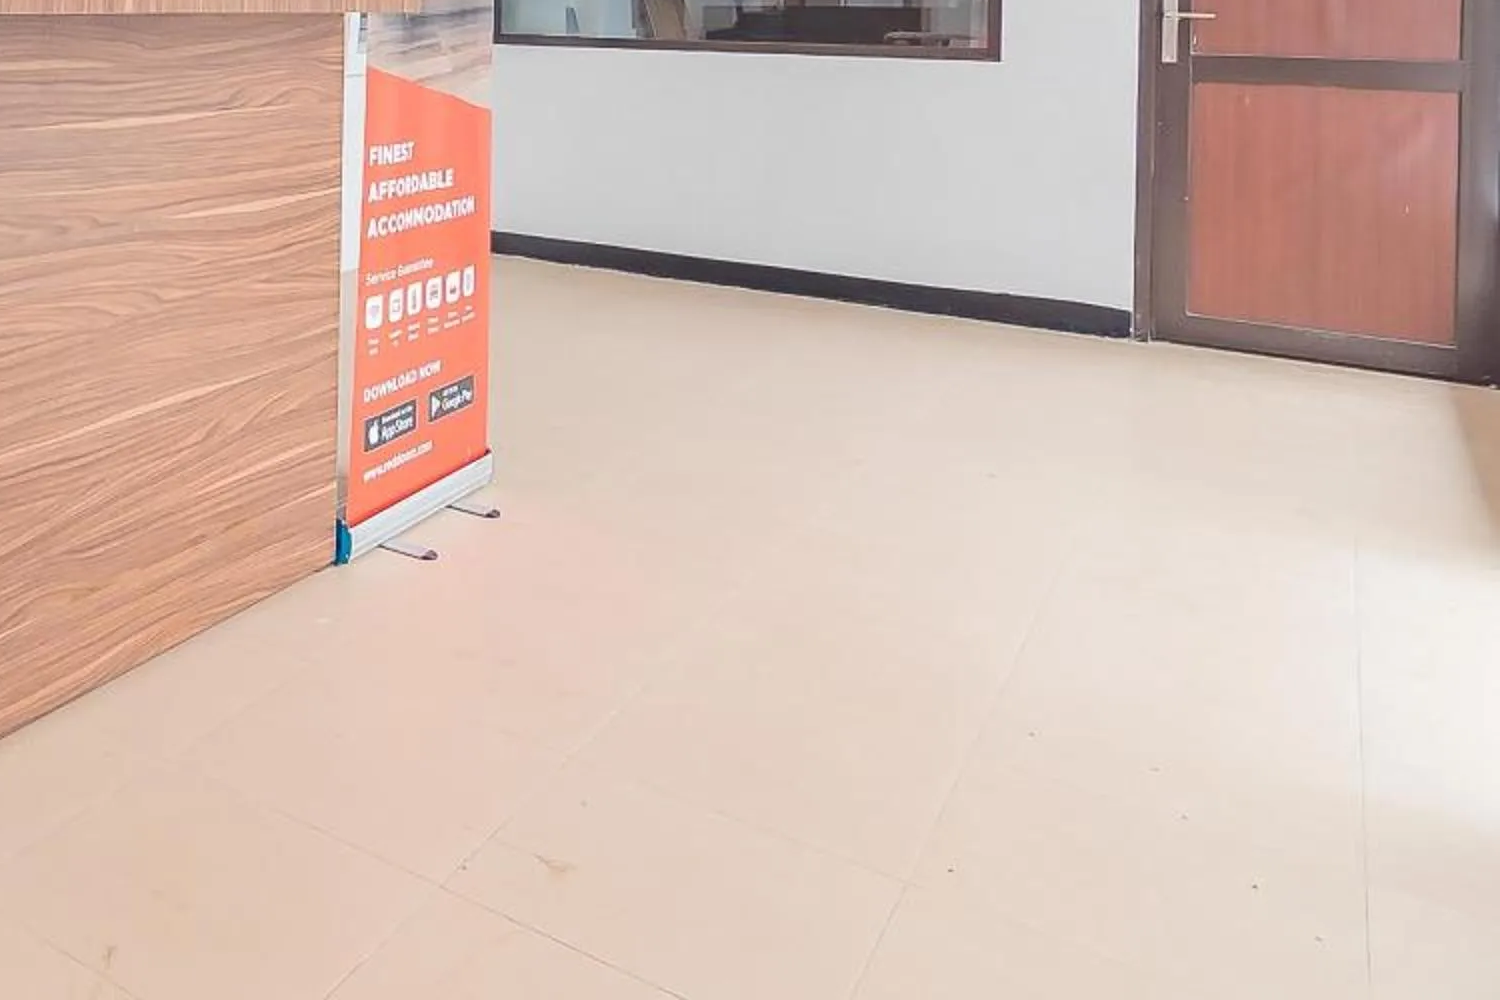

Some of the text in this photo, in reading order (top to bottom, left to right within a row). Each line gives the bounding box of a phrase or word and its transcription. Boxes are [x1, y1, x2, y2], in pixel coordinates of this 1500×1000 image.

[369, 141, 415, 166] FINEST
[367, 168, 455, 203] AFFORDABLE
[367, 195, 476, 239] ACCOMMODATION
[363, 370, 418, 403] DOWNLOAD
[419, 360, 442, 381] NOW
